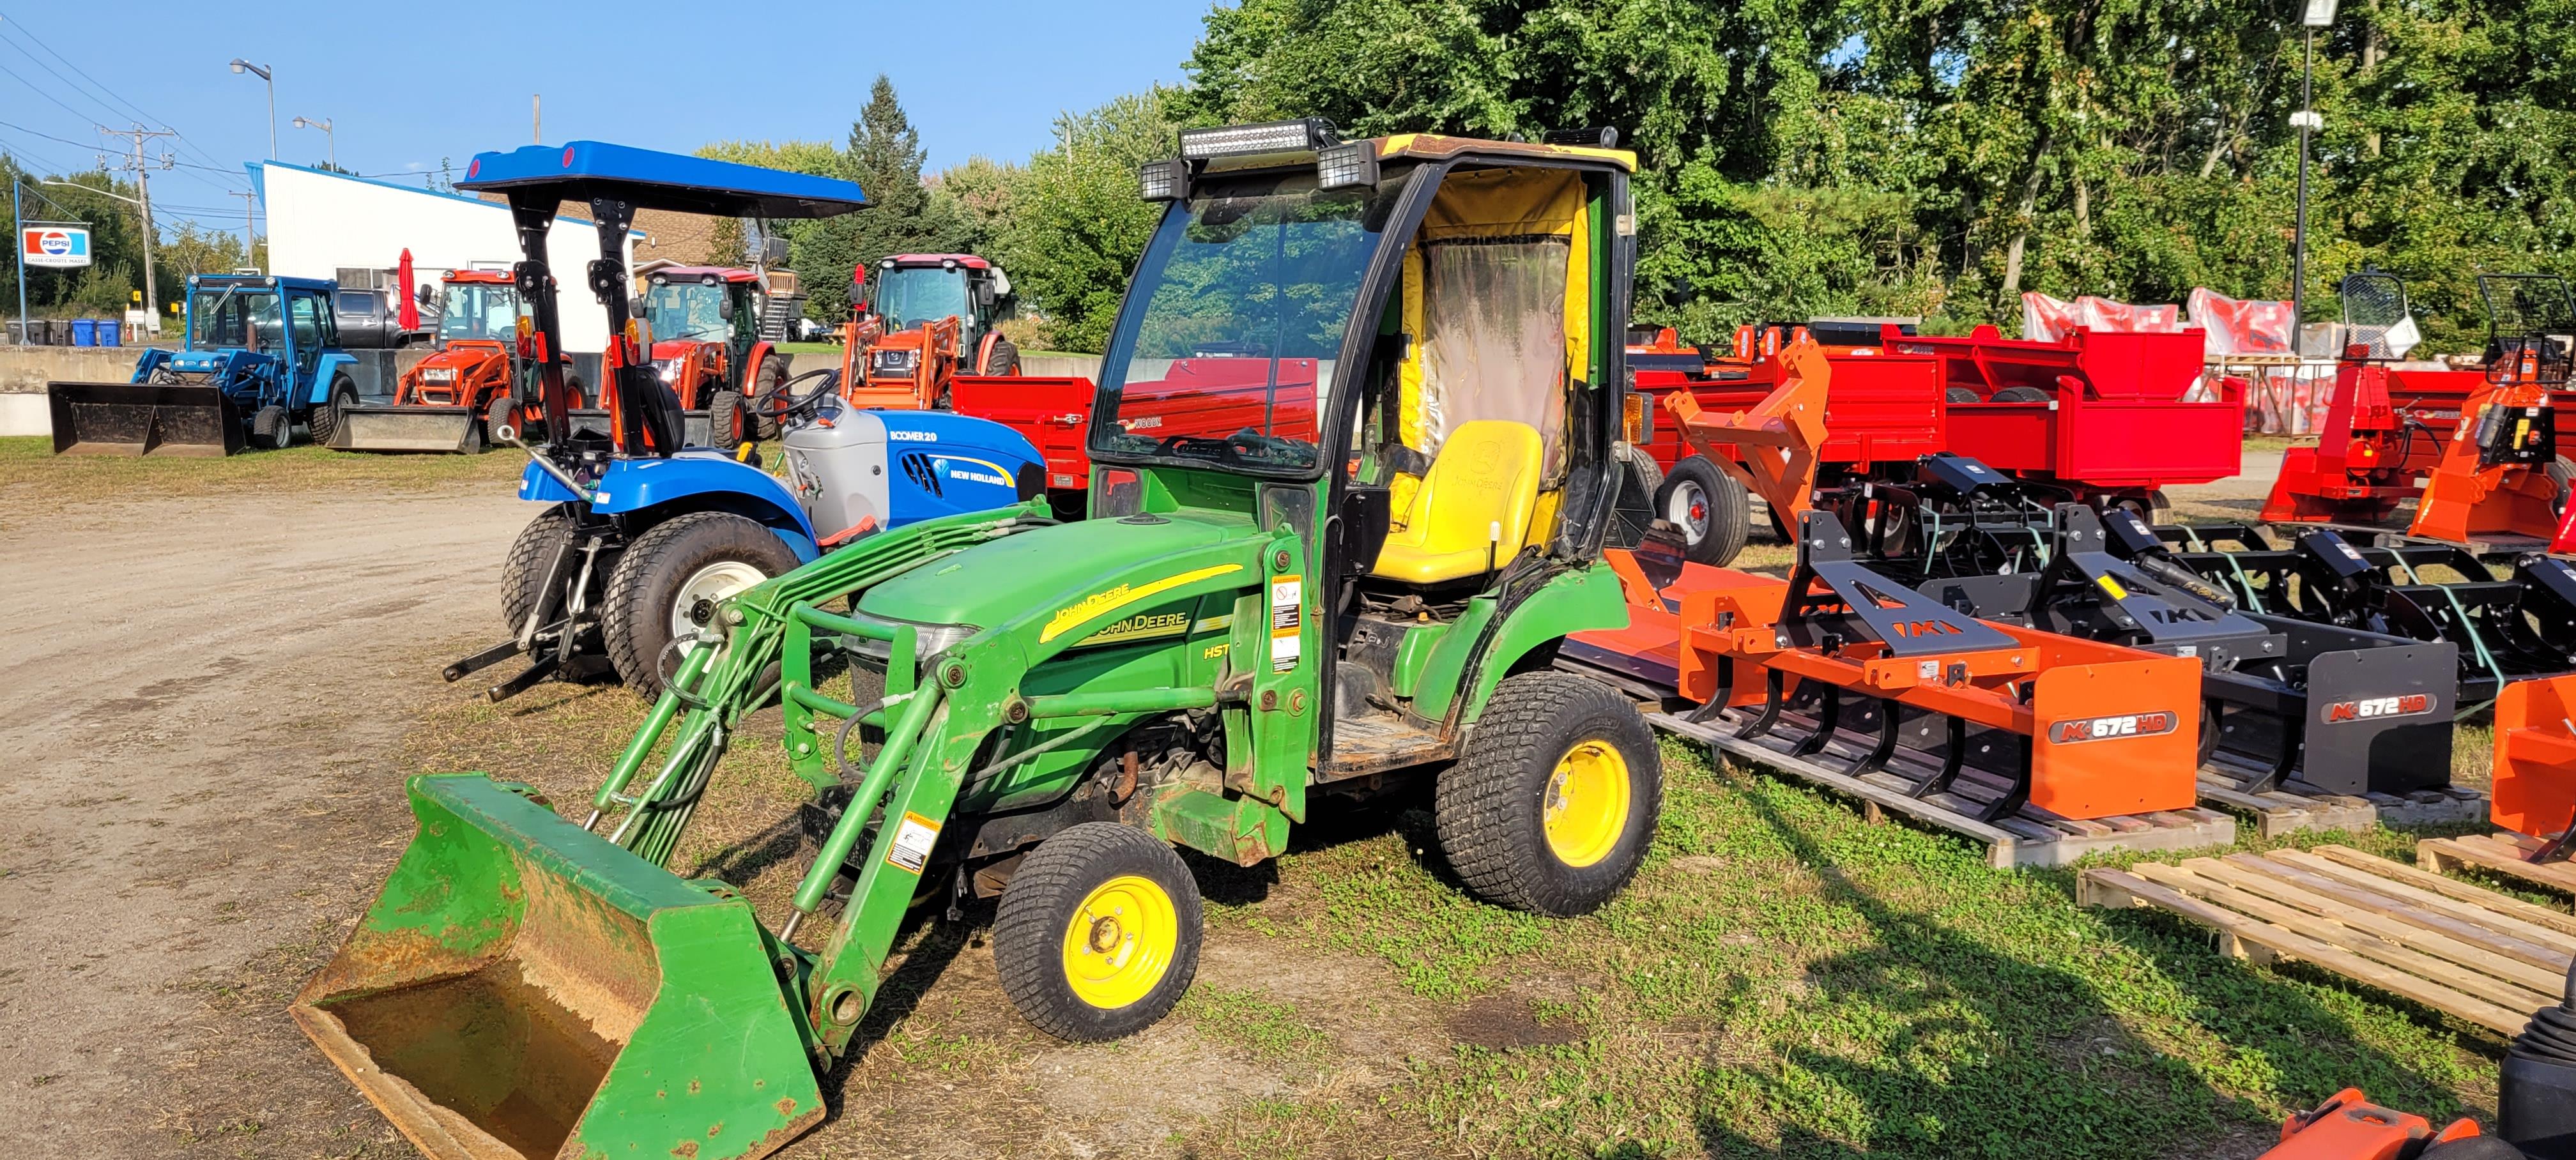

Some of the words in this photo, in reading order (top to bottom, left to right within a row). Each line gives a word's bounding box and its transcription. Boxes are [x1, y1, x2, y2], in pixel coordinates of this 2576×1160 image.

[890, 431, 924, 441] BOOMER
[924, 432, 937, 441] 20
[951, 470, 970, 479] NEW
[970, 472, 1004, 485] HOLLAND
[1052, 601, 1087, 624] JOHN
[1087, 583, 1130, 607] DEERE
[1134, 612, 1186, 631] DEERE
[1204, 643, 1230, 659] HST
